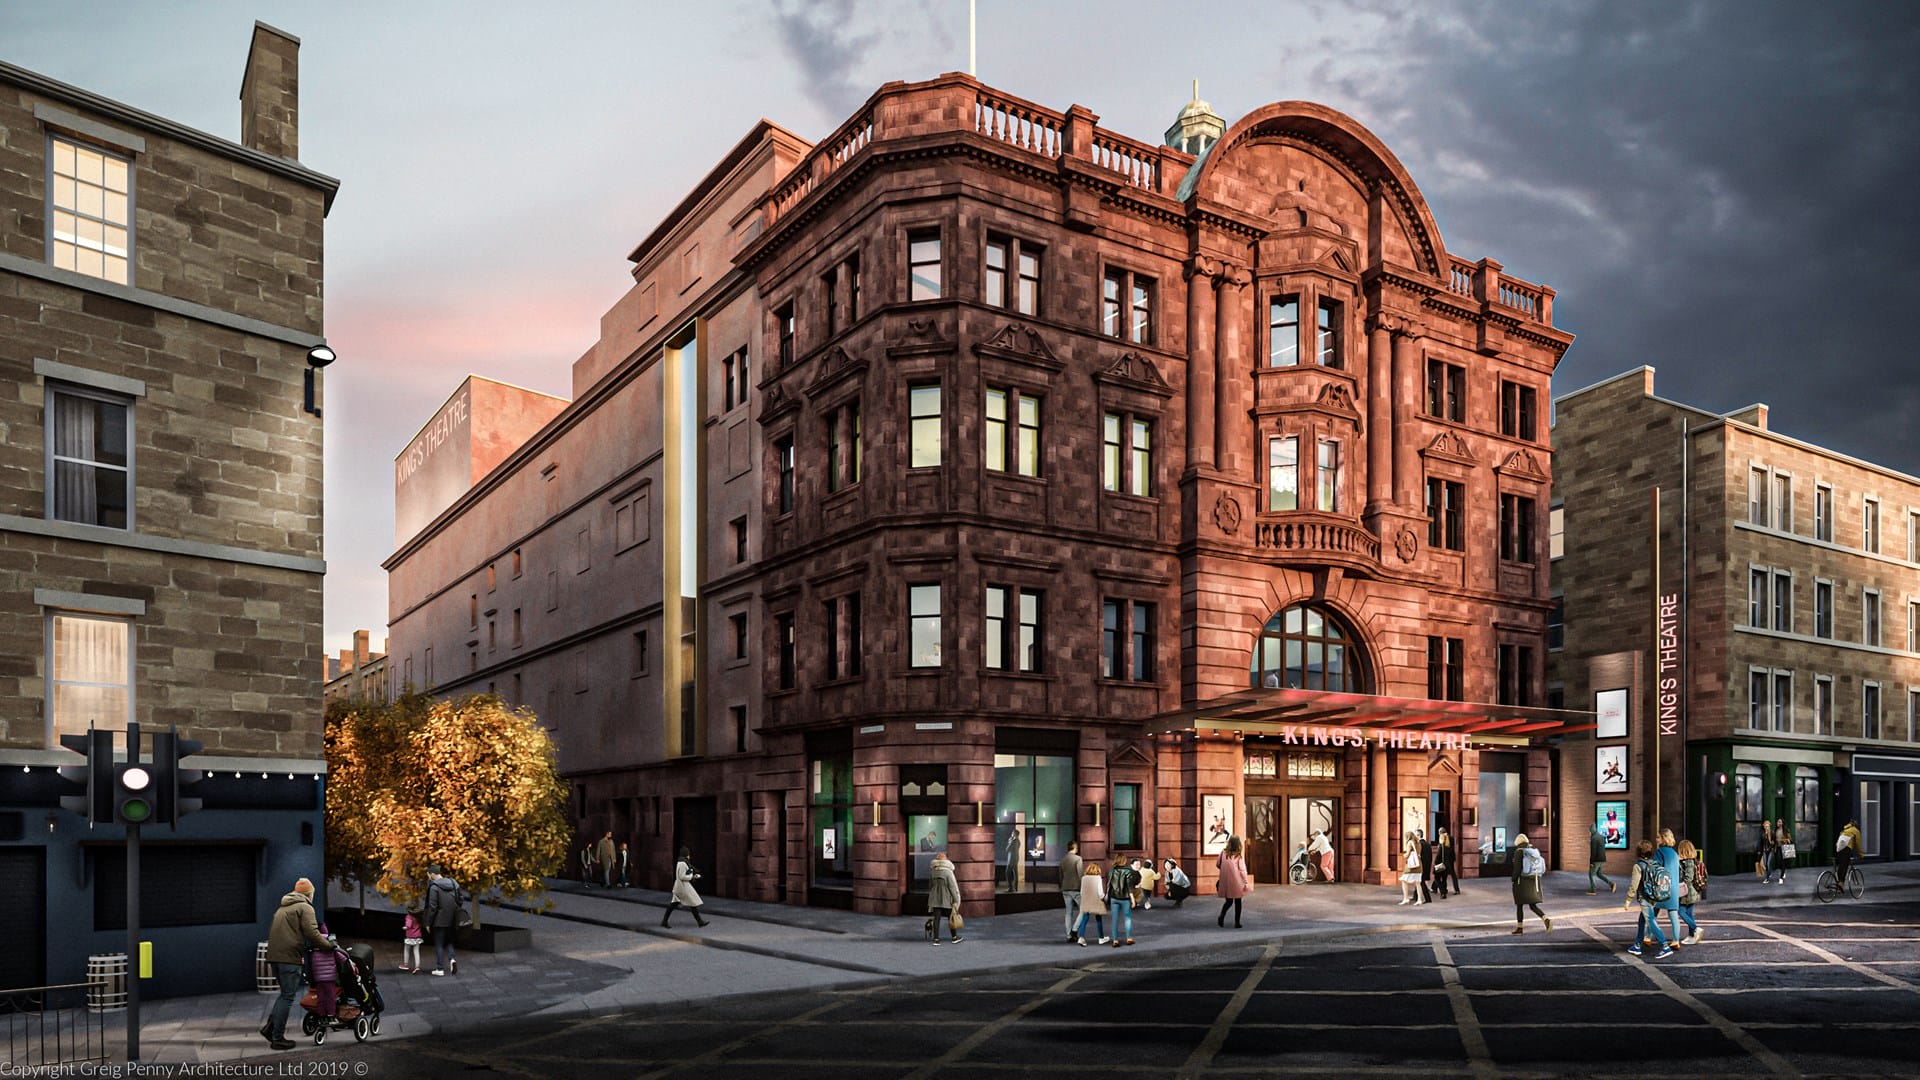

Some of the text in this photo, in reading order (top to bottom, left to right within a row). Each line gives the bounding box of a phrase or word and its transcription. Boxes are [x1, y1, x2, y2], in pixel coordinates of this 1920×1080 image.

[425, 392, 468, 457] THEATRE
[1661, 593, 1677, 735] KING'S THEATRE
[1284, 725, 1471, 750] KING'S THEATRE
